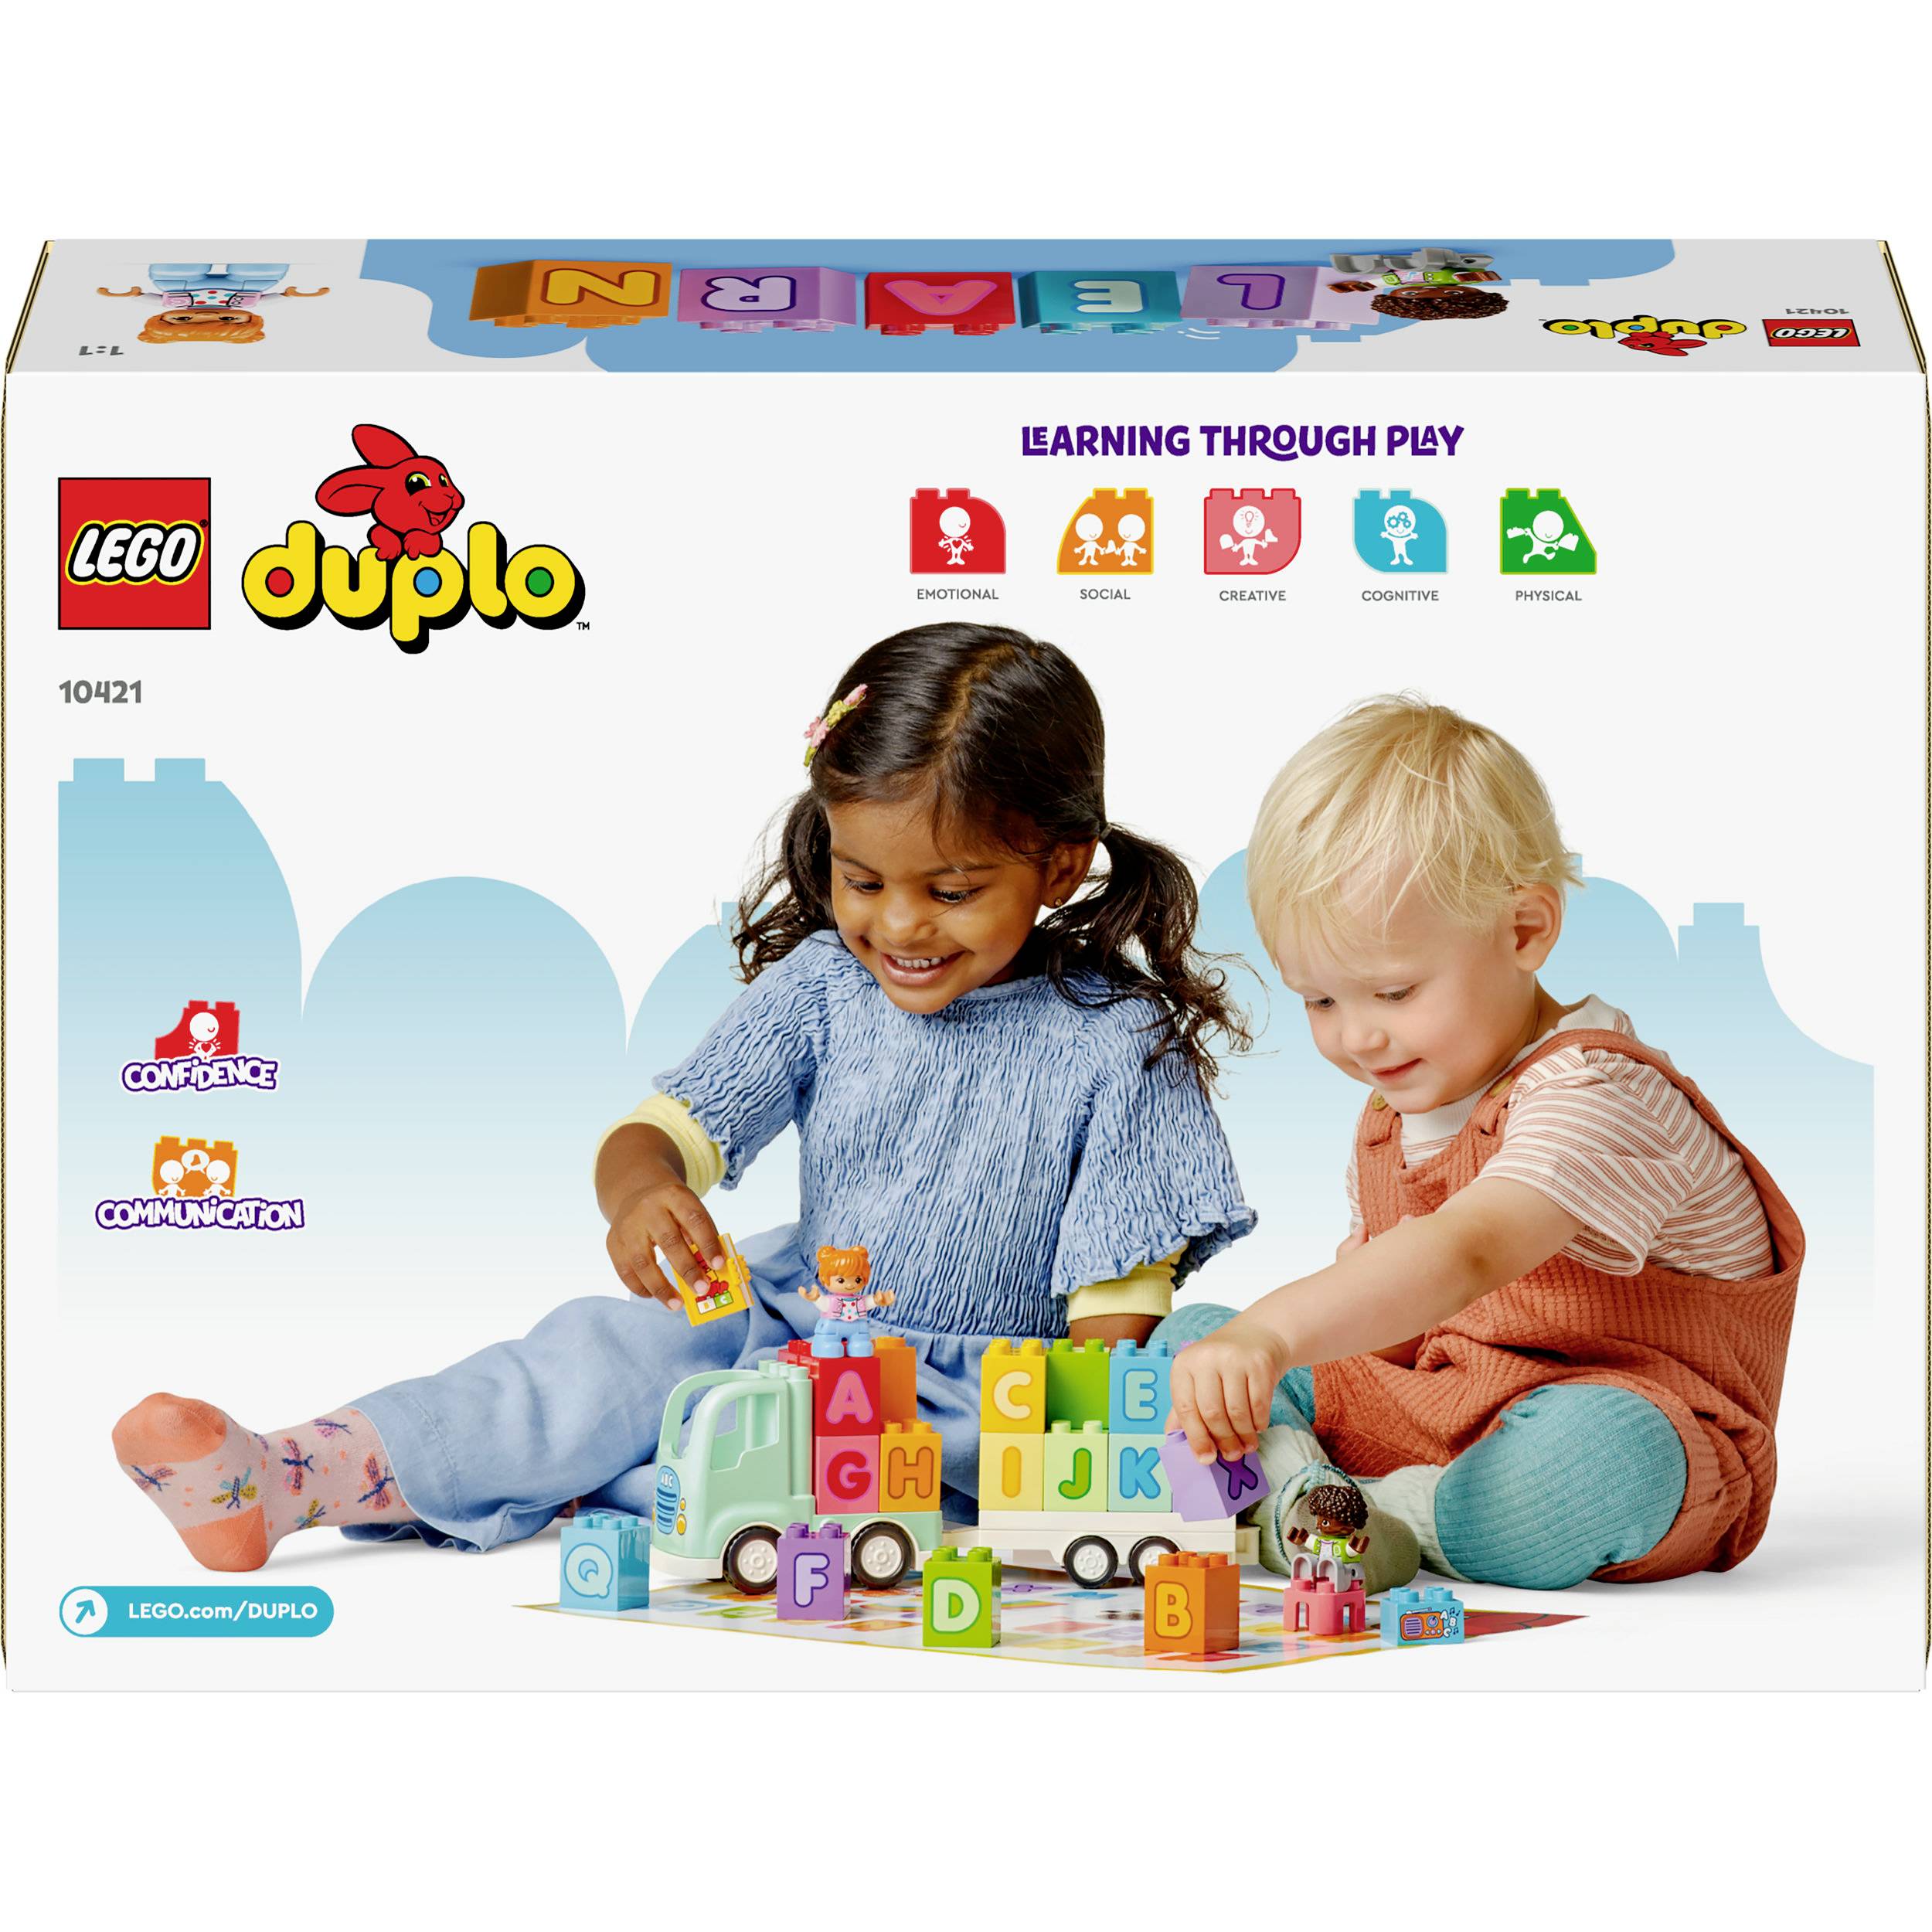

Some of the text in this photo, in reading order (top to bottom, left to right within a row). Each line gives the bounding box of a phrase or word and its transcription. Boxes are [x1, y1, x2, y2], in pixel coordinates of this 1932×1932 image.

[1543, 315, 1852, 339] LEGO duplo
[79, 345, 124, 355] 1:1
[1022, 424, 1464, 461] LEARNING THROUGH PLAY
[66, 521, 203, 585] LEGO
[241, 520, 585, 654] duplo
[917, 589, 999, 600] EMOTIONAL
[1080, 589, 1131, 600] SOCIAL
[1219, 590, 1287, 602] CREATIVE
[1361, 590, 1439, 602] COGNITIVE
[1515, 590, 1583, 602] PHYSICAL
[59, 679, 143, 704] 10421
[826, 1371, 873, 1424] A
[992, 1368, 1157, 1420] C E
[825, 1446, 934, 1502] G H
[1058, 1447, 1092, 1500] J
[1119, 1447, 1162, 1499] K
[564, 1543, 614, 1598] Q
[792, 1552, 831, 1608] F
[128, 1600, 318, 1621] LEGO.com/DUPLO
[930, 1577, 981, 1634] D
[1152, 1580, 1194, 1638] B
